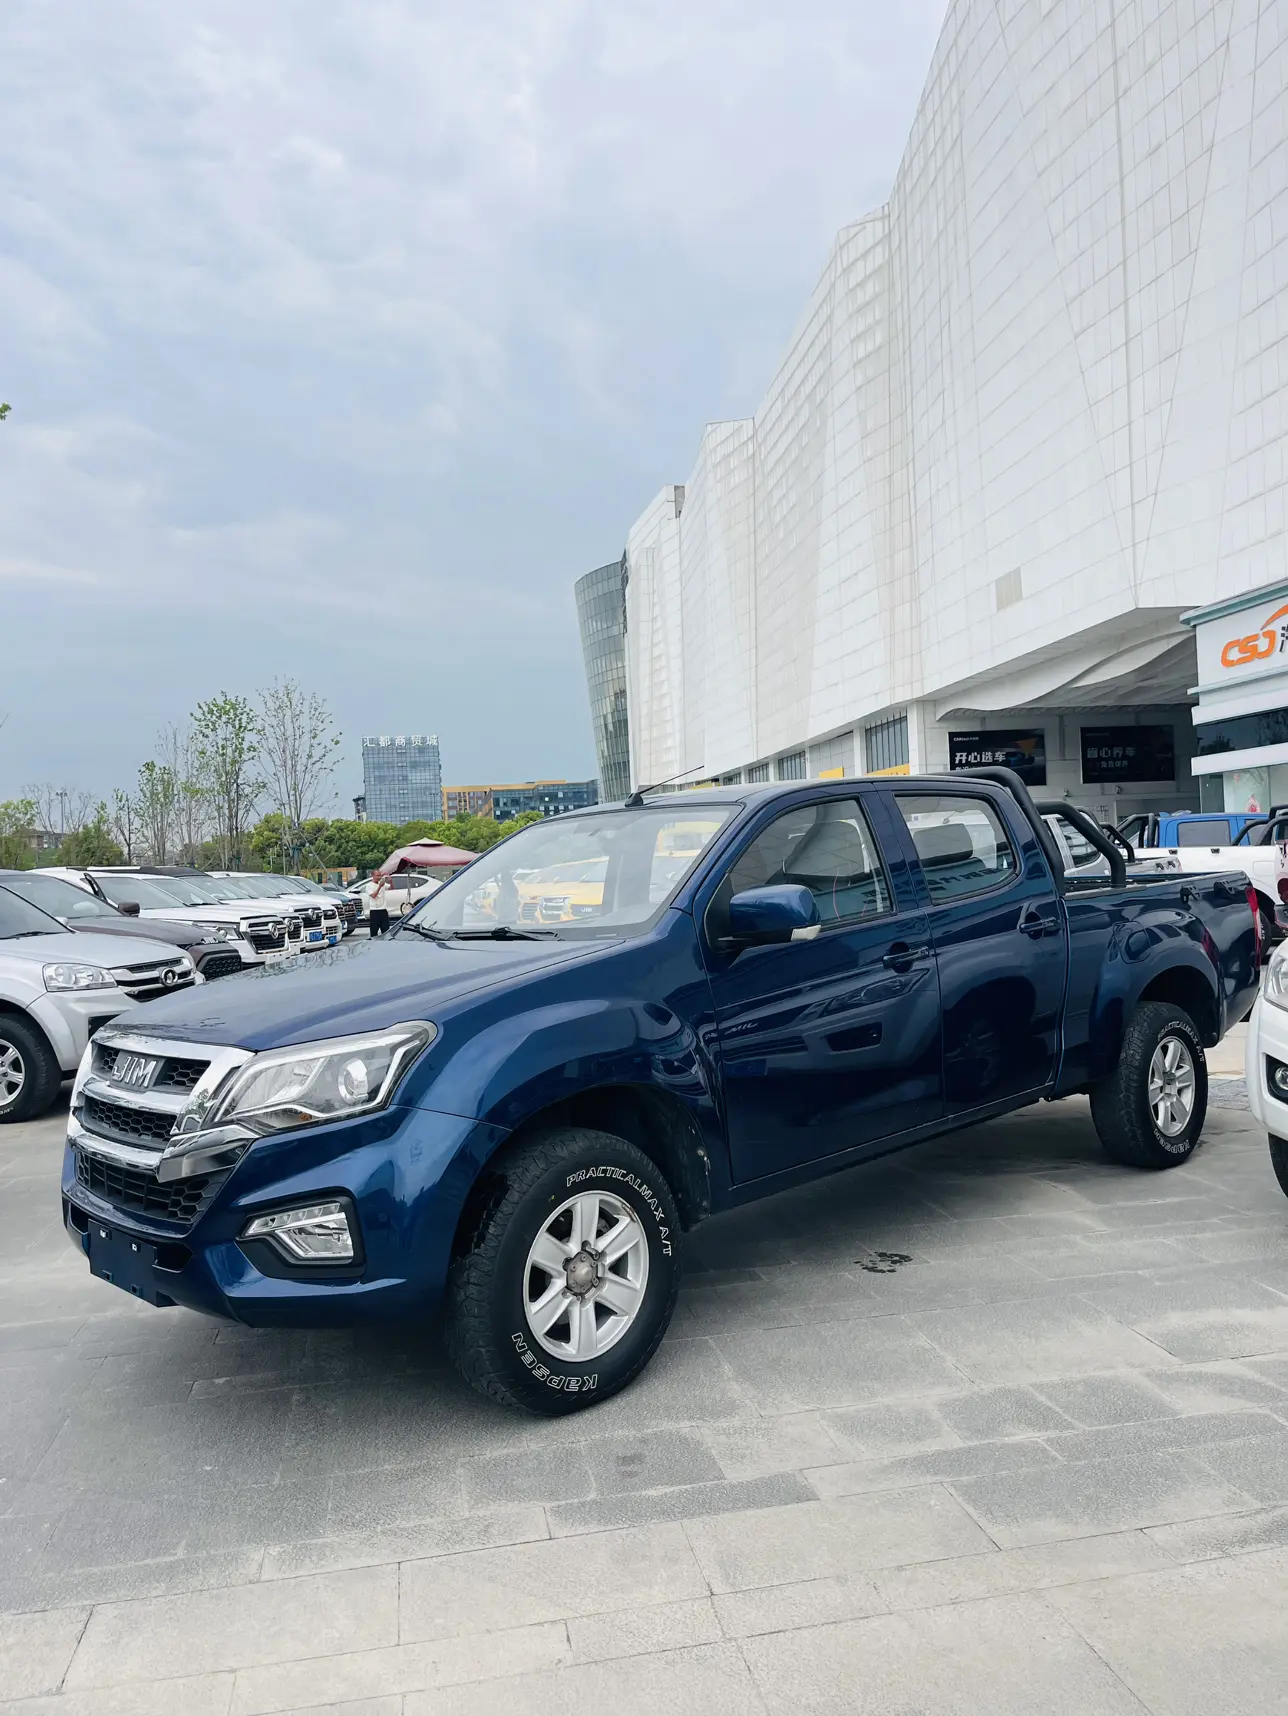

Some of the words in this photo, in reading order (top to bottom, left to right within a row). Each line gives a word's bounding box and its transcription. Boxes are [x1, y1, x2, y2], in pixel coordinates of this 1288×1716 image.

[1221, 629, 1277, 668] CSJ
[954, 751, 1007, 764] 开心选车
[566, 1165, 665, 1220] PRACTICALMAX
[659, 1225, 672, 1257] A/T
